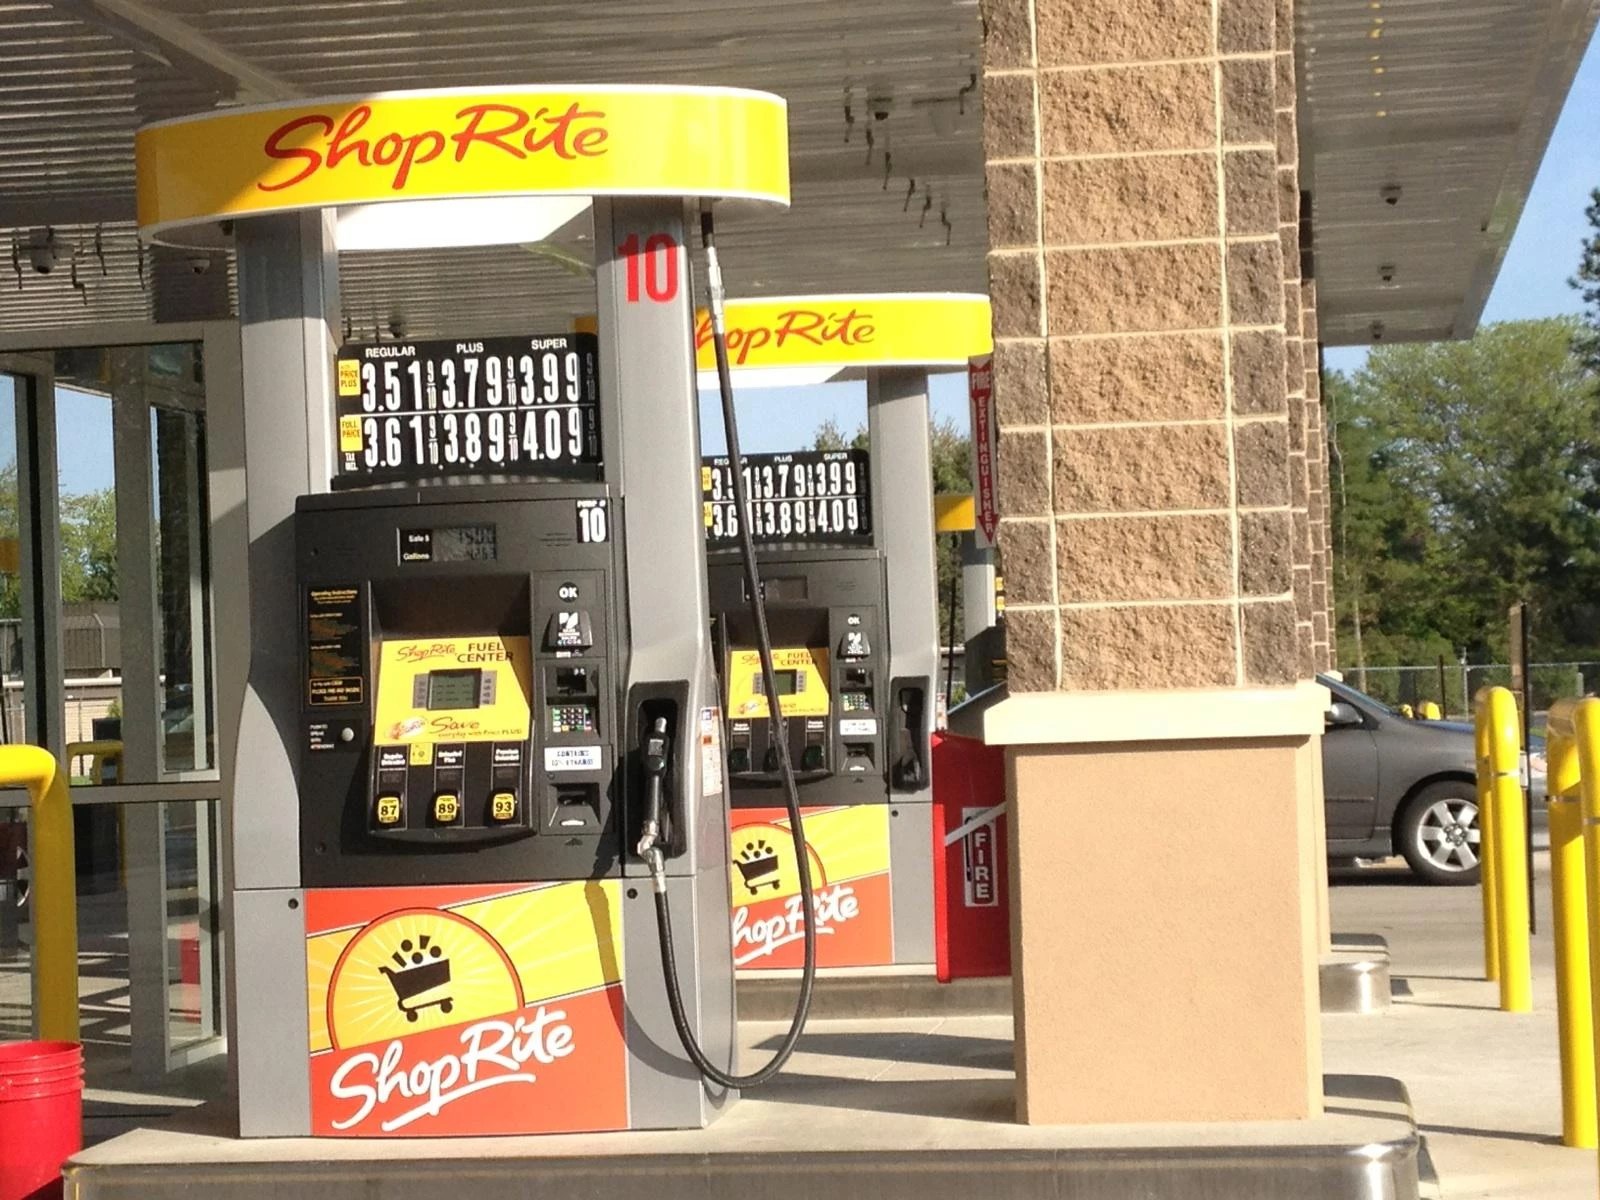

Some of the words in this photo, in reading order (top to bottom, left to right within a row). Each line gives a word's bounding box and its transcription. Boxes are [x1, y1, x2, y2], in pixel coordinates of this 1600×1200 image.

[257, 102, 608, 190] ShopRite
[617, 232, 679, 304] 10
[695, 309, 875, 364] hopRite
[456, 343, 484, 354] PLUS
[531, 338, 568, 350] SUPER
[365, 346, 416, 358] REGULAR
[341, 379, 357, 388] PLUS
[971, 371, 991, 390] FIRE
[342, 419, 358, 429] FULL
[342, 429, 360, 438] PRICE
[774, 454, 793, 463] PLUS
[824, 452, 848, 461] SUPER
[977, 396, 994, 533] EXTINGUISHER
[579, 507, 607, 543] 10
[403, 552, 430, 561] Gallons
[559, 587, 578, 598] OK
[848, 617, 860, 625] OK
[468, 642, 505, 652] FUEL
[396, 644, 456, 663] ShopRite
[457, 652, 514, 663] CENTER
[429, 716, 480, 734] Save
[380, 805, 397, 816] 87
[438, 803, 455, 814] 89
[495, 801, 513, 812] 93
[974, 832, 990, 899] FIRE
[732, 884, 859, 955] hopRite
[330, 1006, 576, 1131] ShopRite
